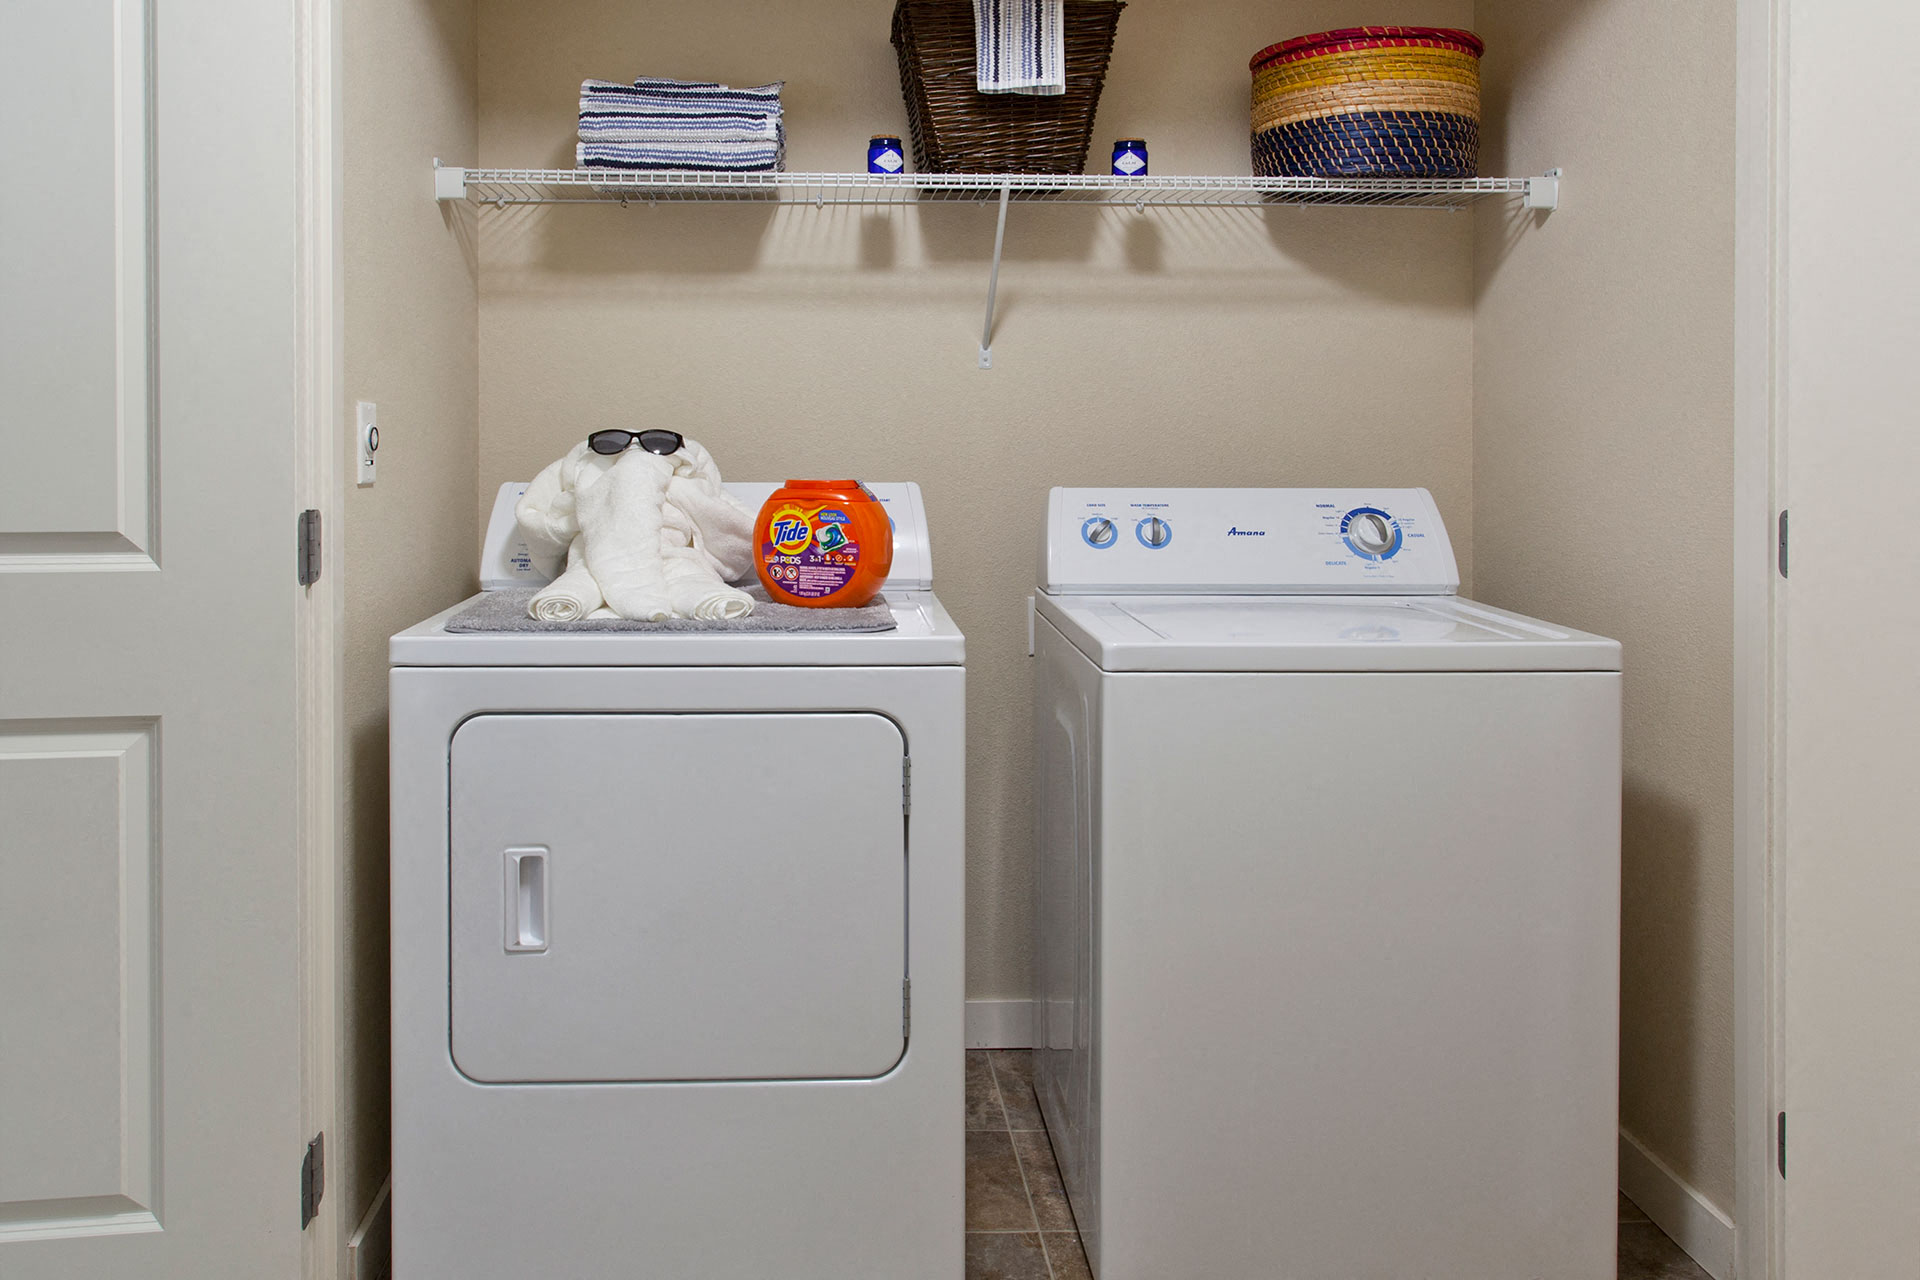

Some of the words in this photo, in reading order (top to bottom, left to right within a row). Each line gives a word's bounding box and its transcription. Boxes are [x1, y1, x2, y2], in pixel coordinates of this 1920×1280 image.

[773, 520, 809, 547] Tide
[1227, 526, 1266, 536] Amana
[780, 555, 802, 565] PODS
